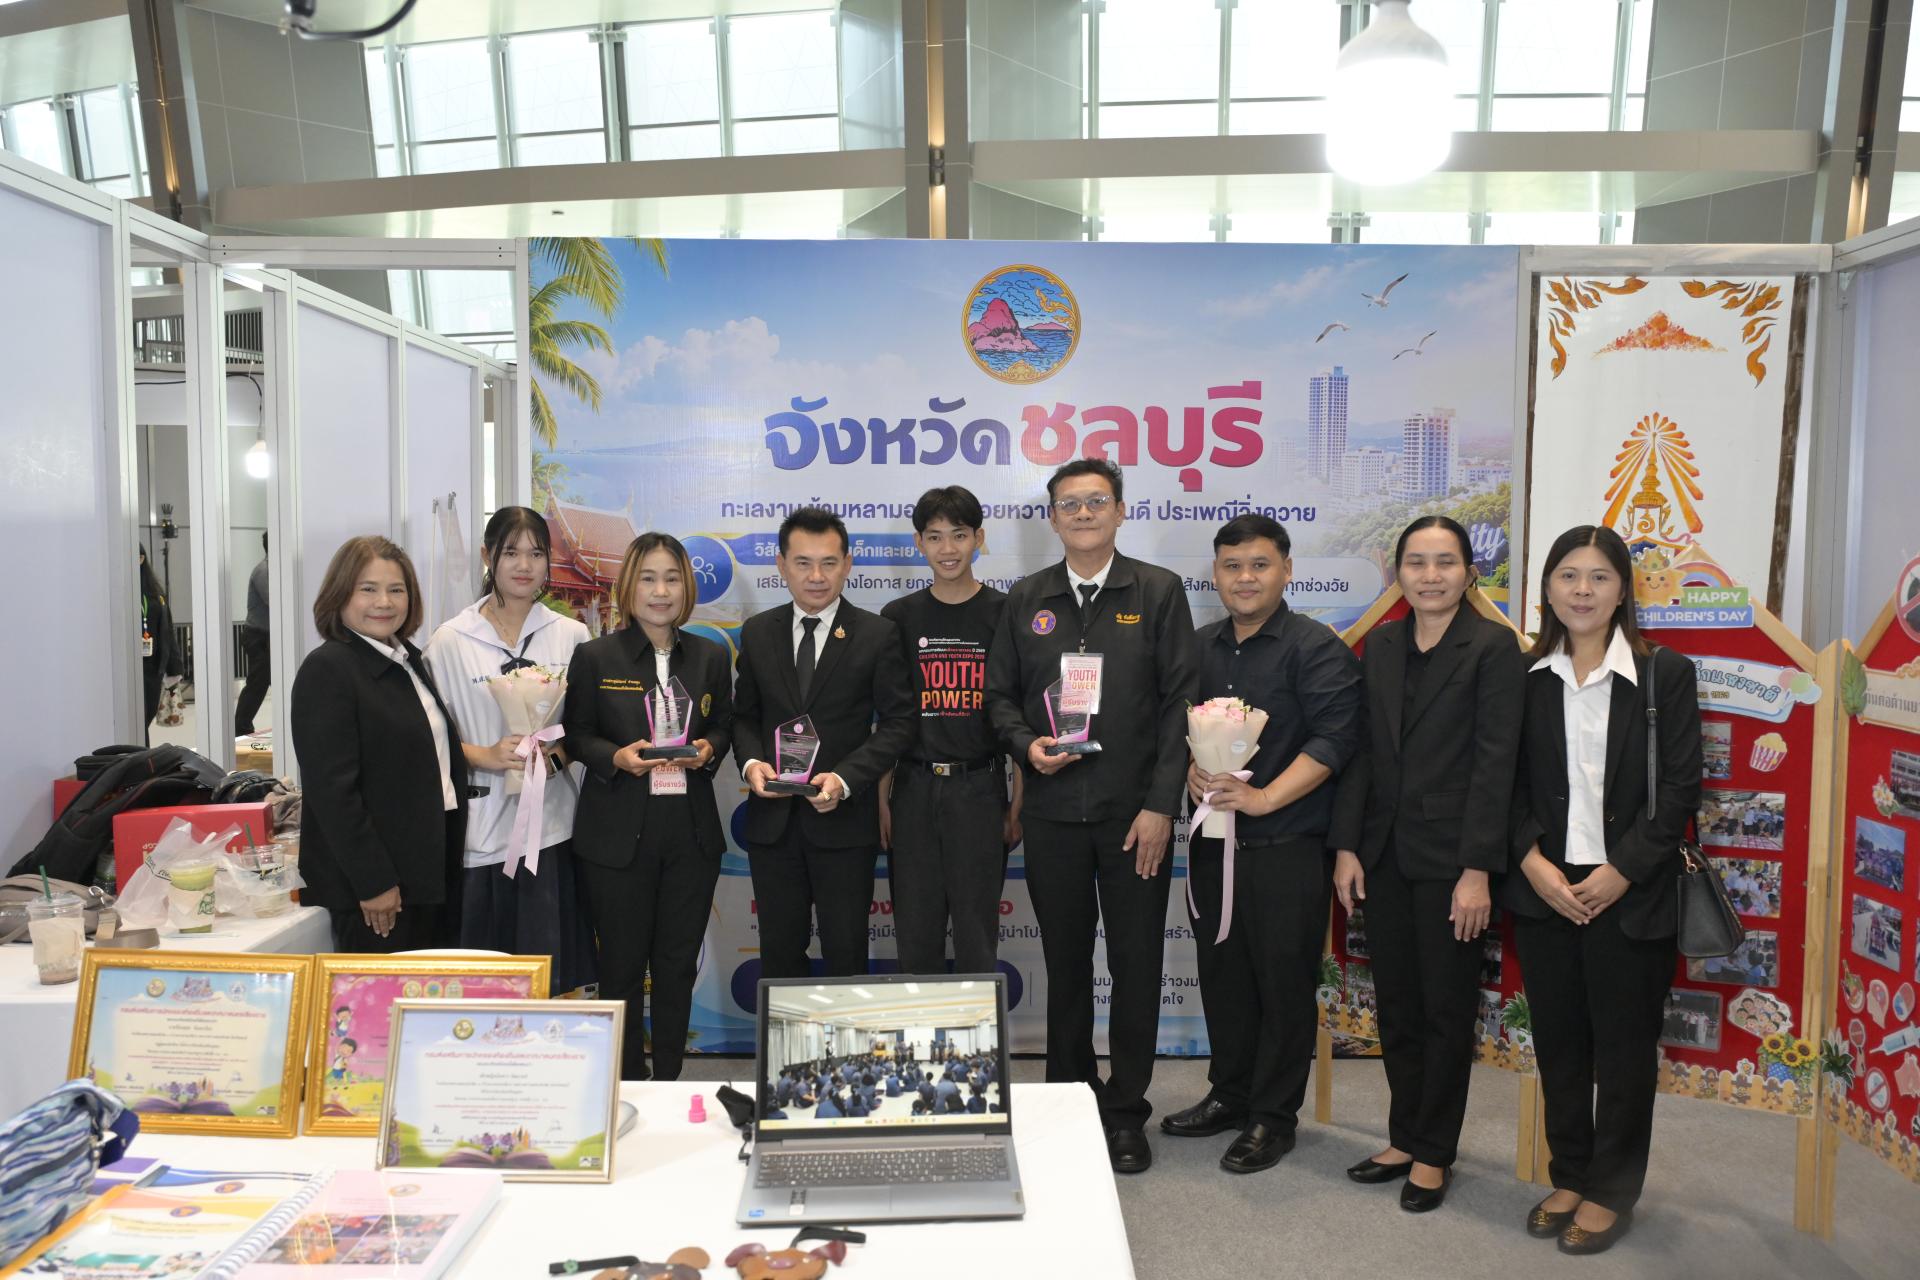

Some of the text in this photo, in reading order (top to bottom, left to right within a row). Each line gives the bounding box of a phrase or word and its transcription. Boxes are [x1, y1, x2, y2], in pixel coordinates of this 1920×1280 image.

[1470, 523, 1506, 560] ity
[1687, 591, 1742, 604] HAPPY
[1718, 611, 1747, 622] DAY
[920, 661, 985, 689] YOUTH
[1067, 669, 1097, 682] YOUTH
[921, 690, 983, 710] POWER
